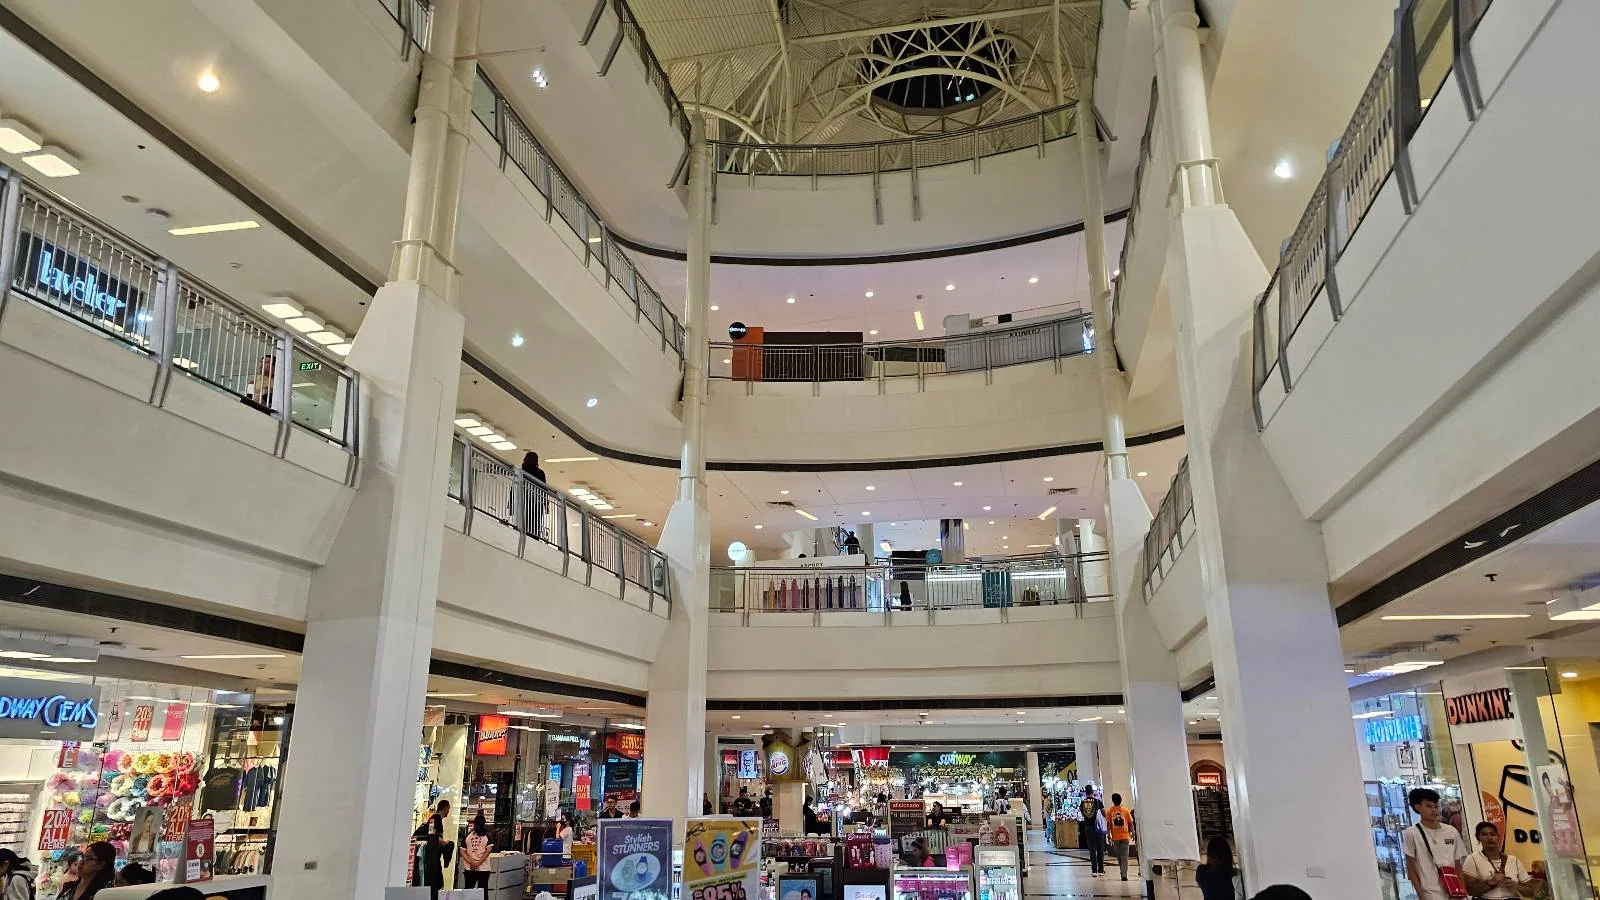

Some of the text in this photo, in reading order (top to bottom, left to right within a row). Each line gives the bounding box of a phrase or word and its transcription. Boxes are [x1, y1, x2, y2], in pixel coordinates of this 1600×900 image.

[301, 362, 318, 370] EXIT
[135, 706, 152, 721] 20%
[132, 721, 149, 731] ALL
[937, 753, 976, 765] SUBWAY
[44, 810, 71, 829] 20%
[42, 828, 66, 841] ALL
[624, 832, 652, 844] Stylish
[39, 839, 65, 850] ITEMS
[612, 841, 660, 855] STUNNERS
